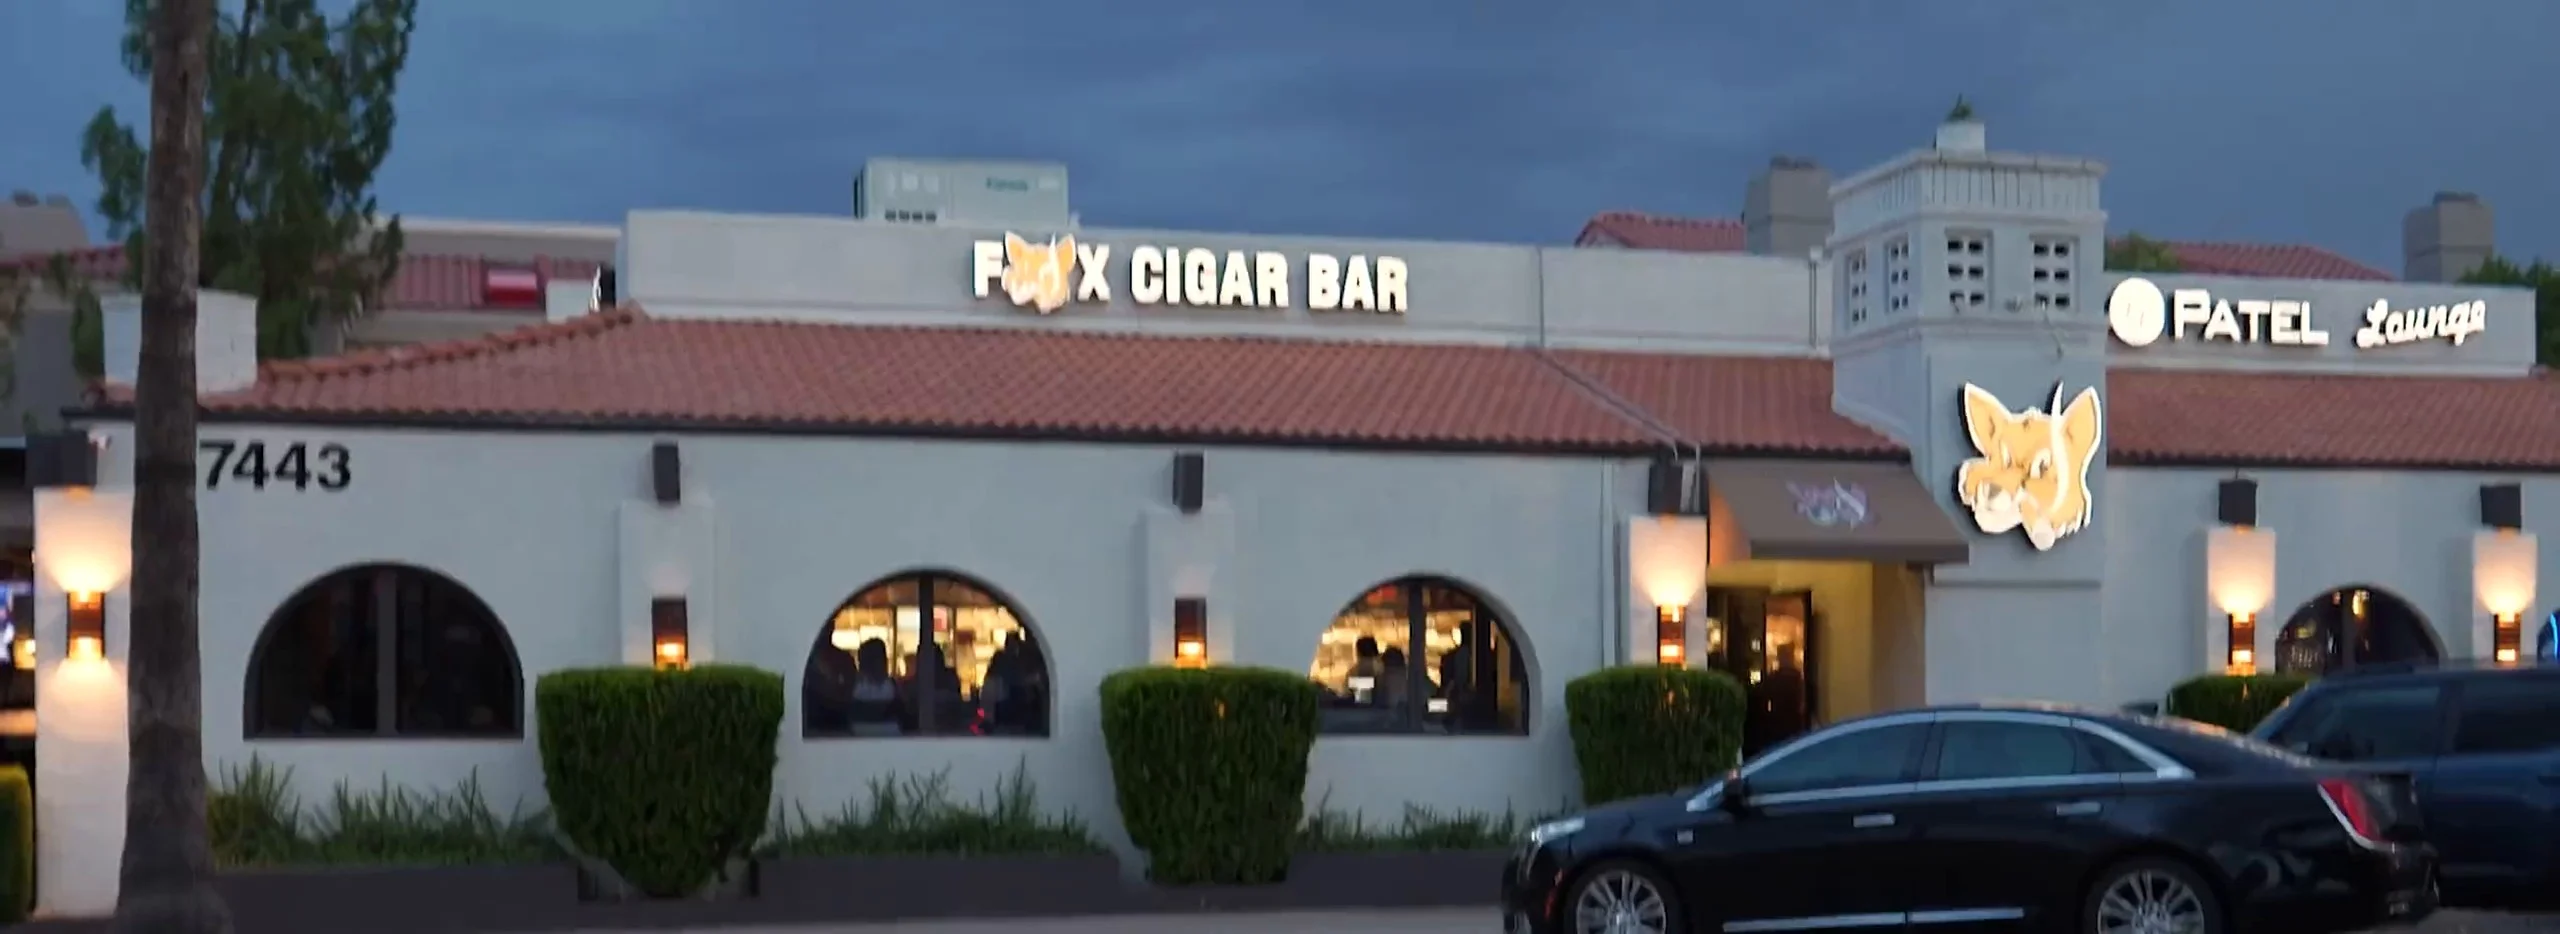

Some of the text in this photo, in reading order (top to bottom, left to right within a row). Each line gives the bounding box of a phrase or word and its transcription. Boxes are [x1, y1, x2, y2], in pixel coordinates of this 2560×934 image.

[974, 240, 1408, 313] FX CIGAR BAR
[2174, 289, 2486, 348] PATEL Lounge
[200, 440, 351, 492] 7443
